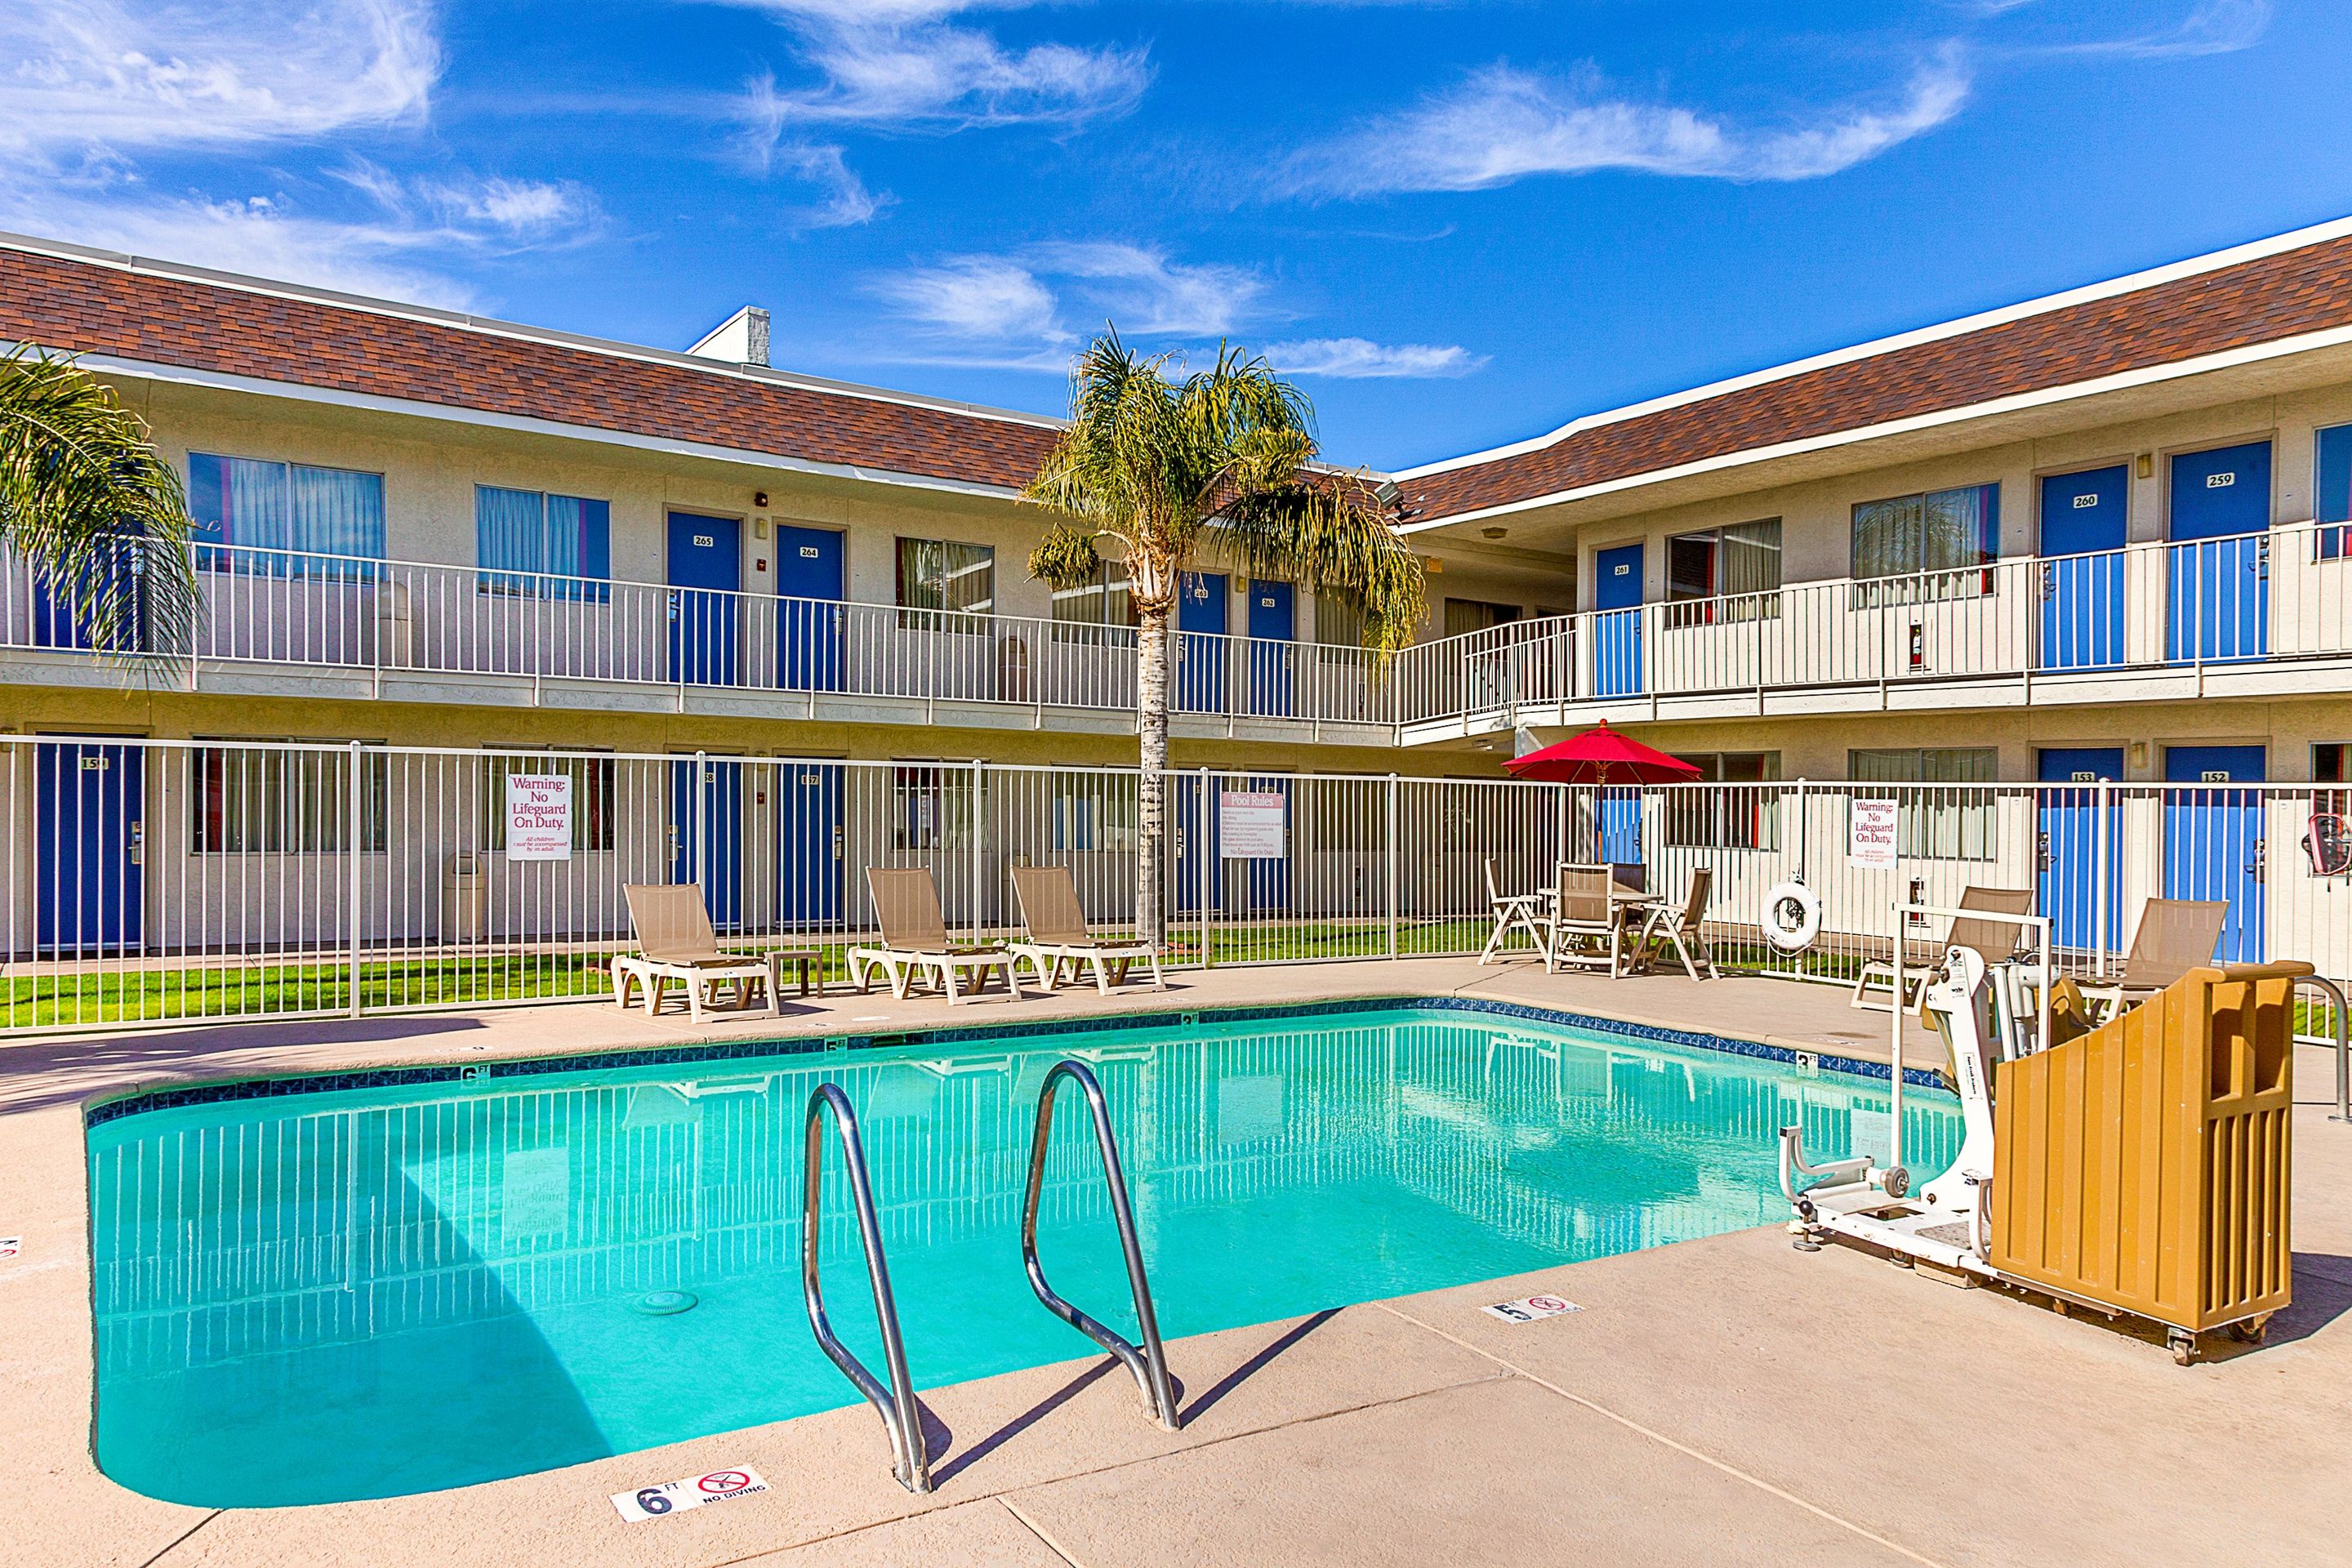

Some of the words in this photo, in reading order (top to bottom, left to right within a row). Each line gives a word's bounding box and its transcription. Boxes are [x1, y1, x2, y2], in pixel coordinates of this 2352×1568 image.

[2209, 474, 2231, 486] 259
[2075, 496, 2096, 506] 260
[696, 537, 711, 546] 265
[802, 549, 817, 557] 264
[1616, 566, 1627, 574] 261
[2074, 773, 2092, 782] 153
[2204, 773, 2225, 782] 152
[513, 777, 565, 792] Warning:
[531, 791, 548, 802] No
[1232, 795, 1250, 806] Pool
[1252, 795, 1274, 807] Rules
[512, 803, 566, 817] Lifeguard
[1855, 802, 1893, 813] Warning:
[1868, 813, 1881, 822] No
[514, 817, 532, 828] On
[536, 817, 564, 831] Duty.
[1855, 822, 1893, 833] Lifeguard
[1855, 833, 1869, 843] On
[1871, 833, 1891, 845] Duty.
[826, 1040, 836, 1051] 5
[462, 1067, 477, 1080] 6
[479, 1065, 488, 1073] FT
[1493, 1304, 1532, 1321] 5
[636, 1488, 672, 1515] 6
[664, 1482, 679, 1491] FT
[703, 1495, 721, 1503] NO
[724, 1485, 766, 1499] DIVING
